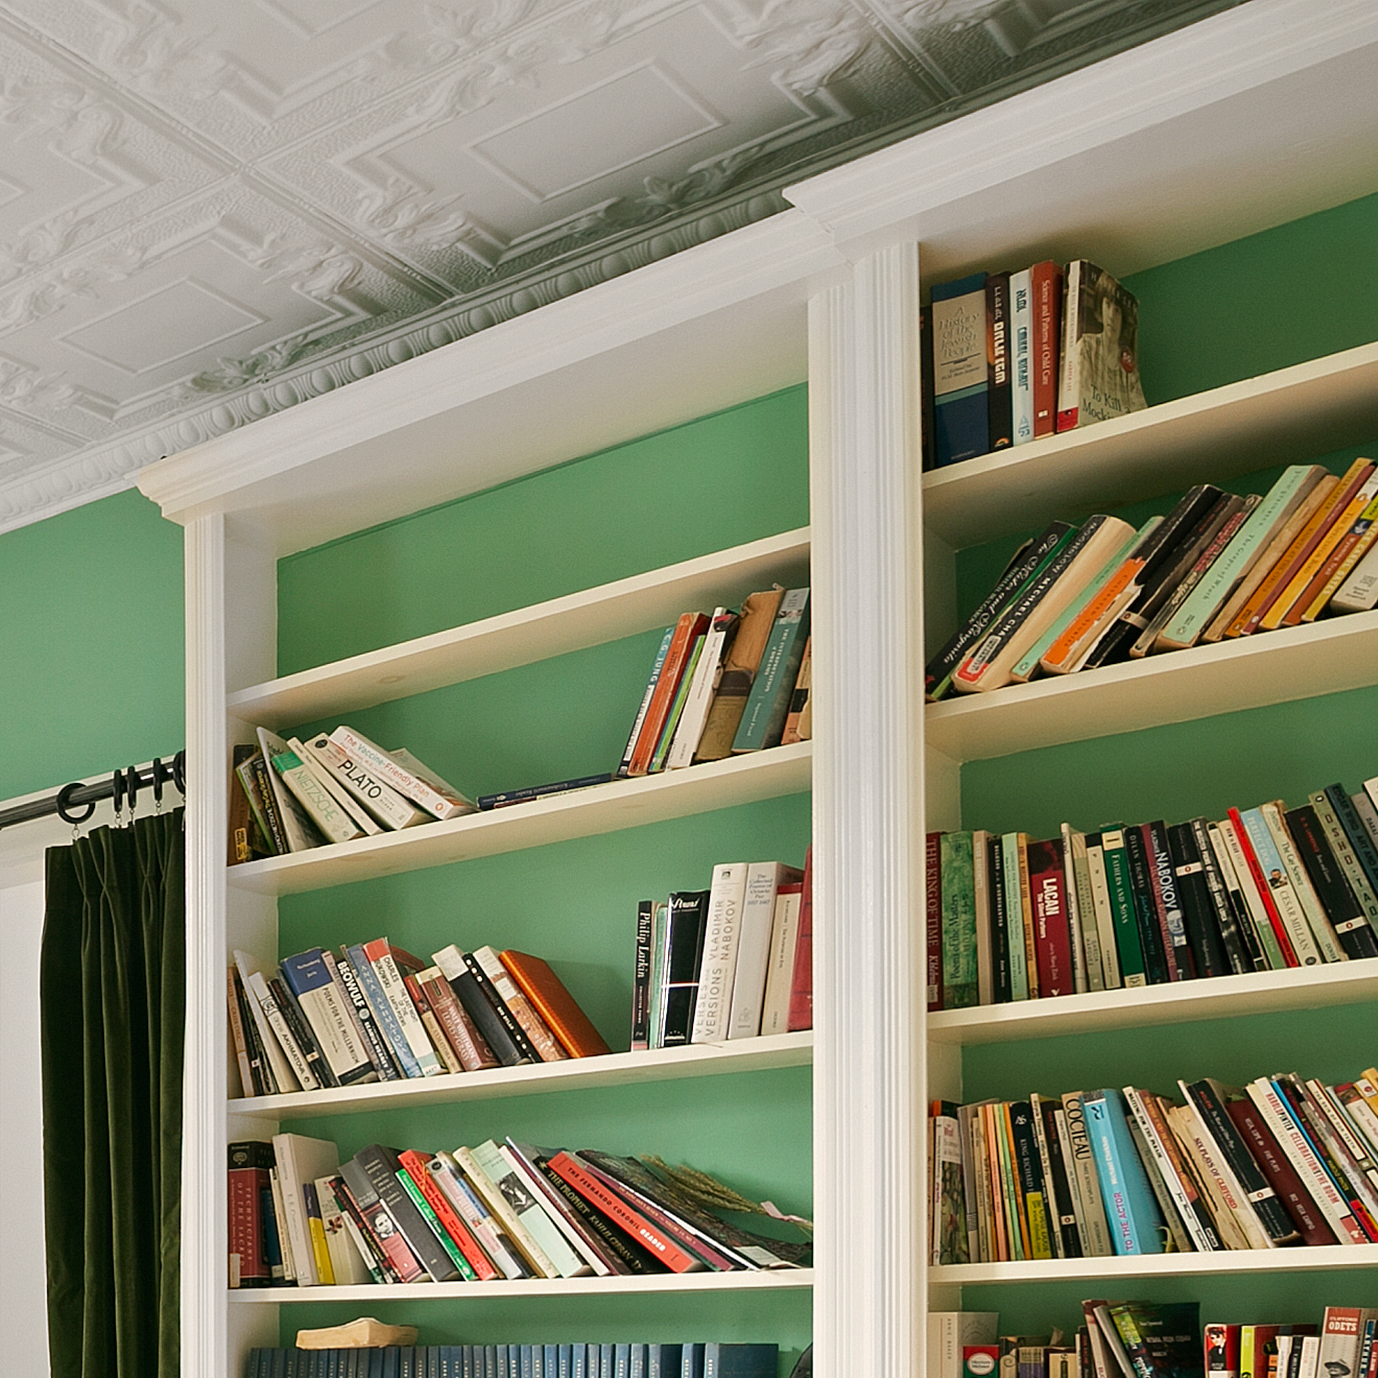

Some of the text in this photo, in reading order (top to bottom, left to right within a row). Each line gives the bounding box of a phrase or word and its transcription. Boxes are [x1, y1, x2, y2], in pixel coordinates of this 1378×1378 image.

[1042, 280, 1050, 303] Science
[1042, 351, 1050, 370] Child
[943, 533, 1059, 664] The Master and Margarita
[649, 657, 665, 683] JUNG
[764, 651, 776, 676] DREAMS
[764, 642, 786, 693] INTERPRETATION
[747, 723, 757, 736] Freud
[338, 759, 382, 799] PLATO
[344, 734, 357, 746] The
[413, 779, 430, 798] Plan
[293, 770, 340, 822] NIETZSCHE
[1129, 835, 1145, 888] DYLAN THOMAS
[1150, 829, 1160, 853] VLADIMIR
[1281, 842, 1304, 887] The Gay Science
[926, 839, 938, 946] THE KING OF TIME
[1043, 878, 1059, 916] LACAN
[1111, 854, 1129, 924] FATHERS AND SONS
[1155, 852, 1177, 909] NABOKOV
[708, 901, 723, 960] VLADIMIR
[720, 900, 736, 961] NABOKOV
[1037, 903, 1045, 917] Silent
[1038, 919, 1046, 939] Partners
[1279, 890, 1309, 951] CESAR MILLAN
[636, 912, 650, 978] Philip Larkin
[336, 961, 364, 1007] BEOWULF
[1065, 1098, 1091, 1161] COCTEAU
[547, 1168, 590, 1215] THE PROPHET
[1113, 1192, 1133, 1251] TO THE ACTOR
[1328, 1322, 1357, 1331] ODETS
[1359, 1335, 1370, 1369] ARTHUR
